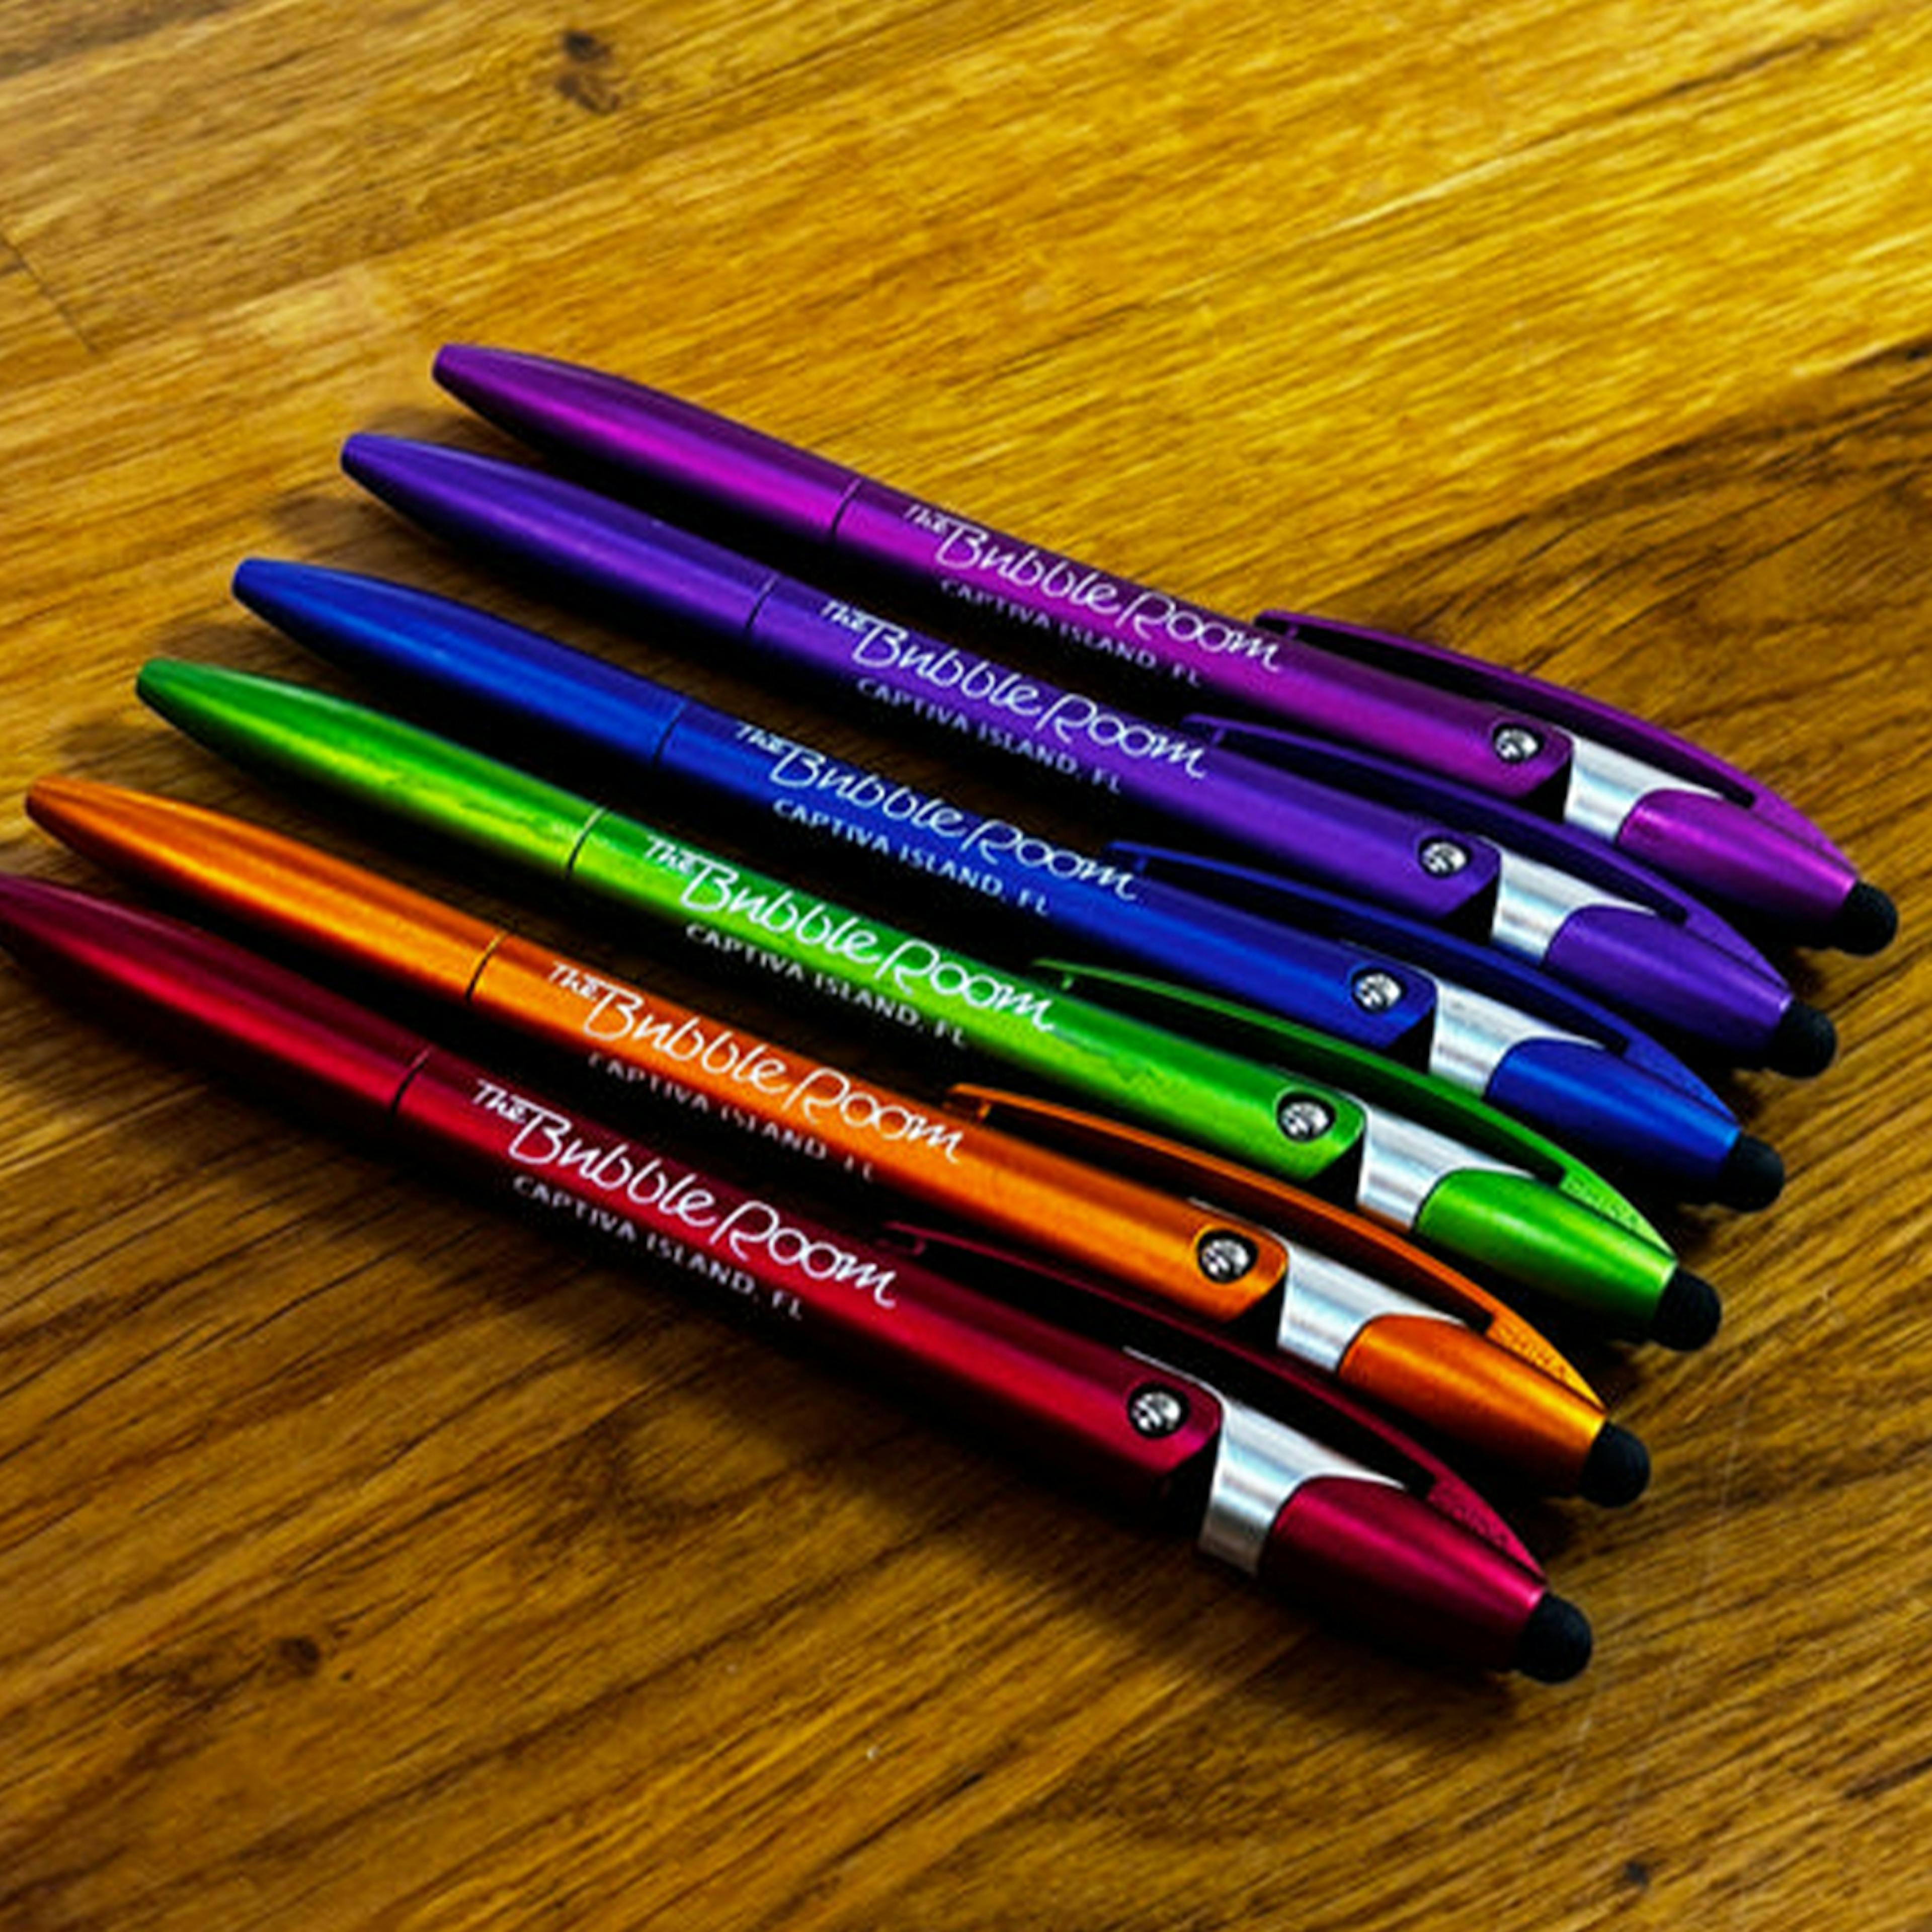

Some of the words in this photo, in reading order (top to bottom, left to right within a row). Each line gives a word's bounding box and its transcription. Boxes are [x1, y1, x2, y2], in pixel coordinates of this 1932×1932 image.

[934, 512, 1121, 615] Bubble
[1114, 591, 1280, 672] Room
[852, 607, 1040, 716] Bubble
[1034, 693, 1205, 778] Room
[857, 678, 969, 734] CAPTIVA
[769, 733, 967, 838] Bubble
[960, 820, 1137, 901] Room
[773, 798, 890, 856] CAPTIVA
[1017, 889, 1049, 917] FL
[679, 851, 881, 964] Bubble
[874, 939, 1055, 1031] Room
[685, 923, 804, 978] CAPTIVA
[584, 973, 791, 1095] Bubble
[783, 1068, 963, 1164] Room
[508, 1093, 717, 1226] Bubble
[708, 1200, 897, 1308] Room
[512, 1175, 636, 1242] CAPTIVA
[771, 1289, 803, 1321] FL
